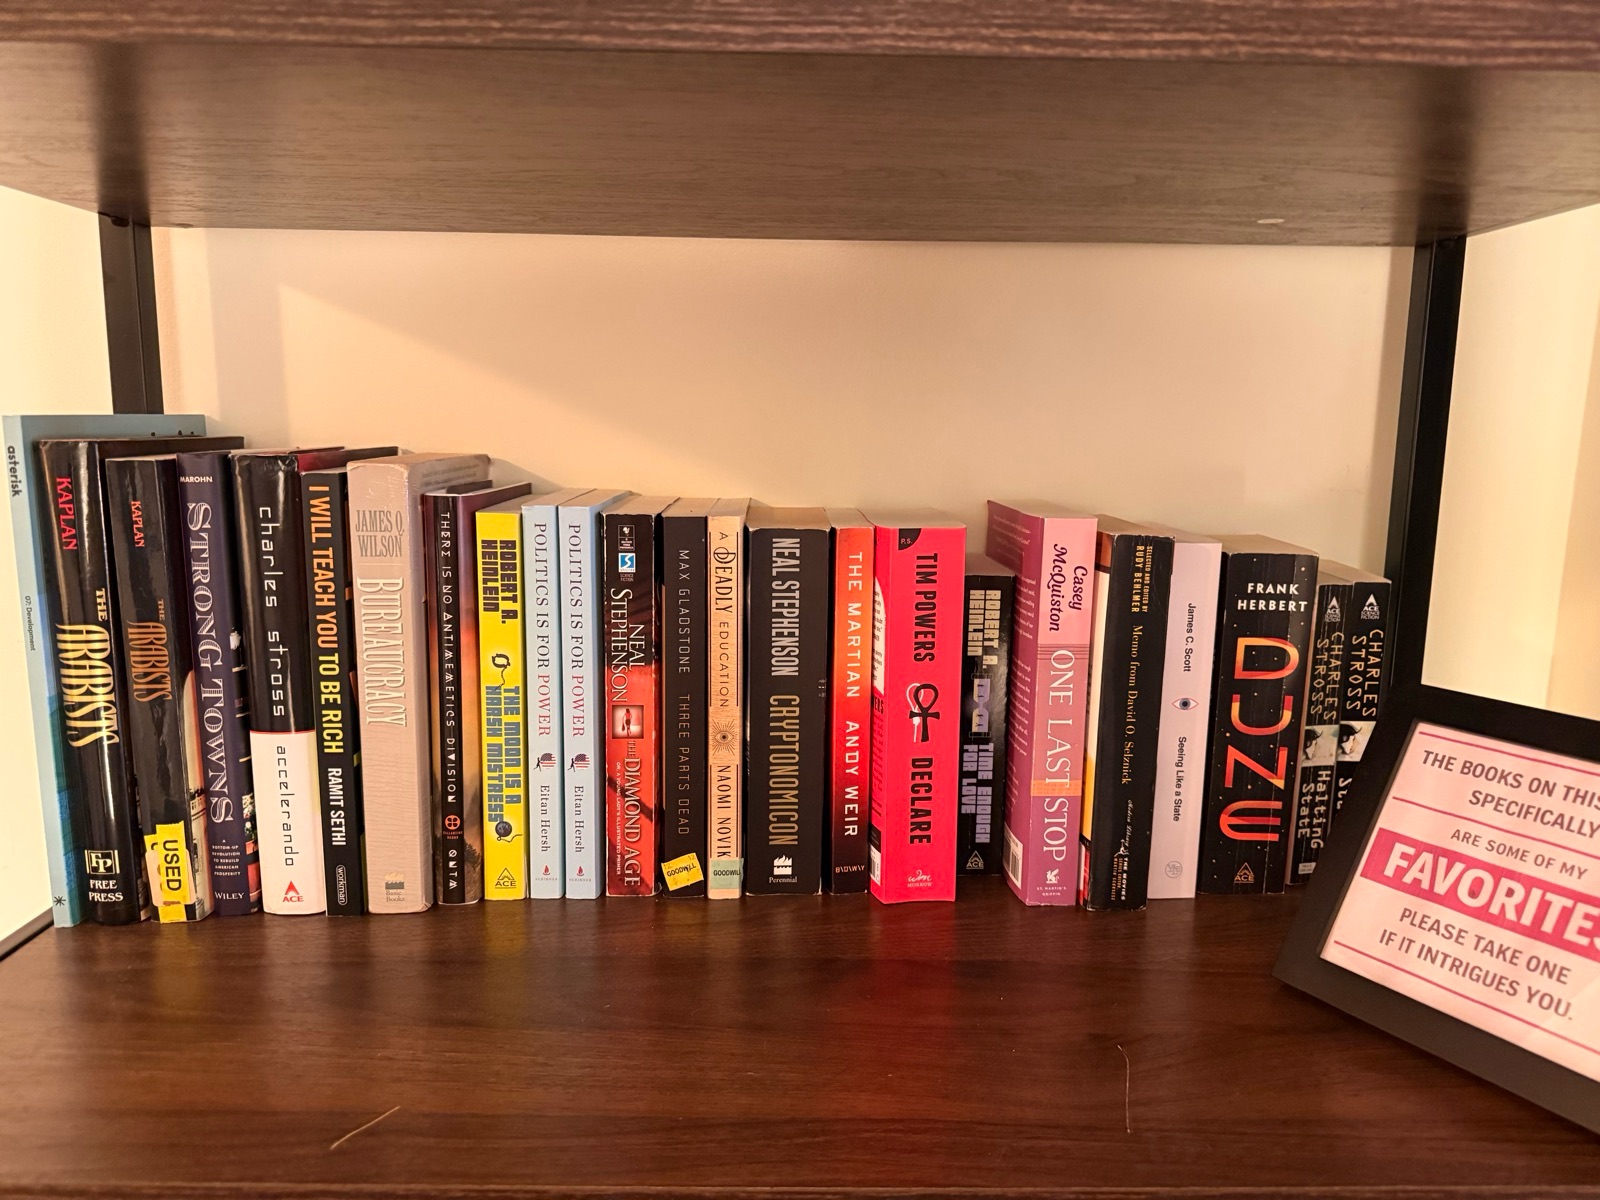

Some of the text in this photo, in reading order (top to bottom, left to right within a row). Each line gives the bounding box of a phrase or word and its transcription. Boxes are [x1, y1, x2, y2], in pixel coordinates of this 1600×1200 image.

[7, 445, 22, 497] asterisk
[179, 475, 213, 483] MAROHN
[56, 477, 77, 550] KAPLAN
[130, 500, 146, 548] KAPLAN
[309, 496, 332, 544] WILL
[355, 509, 392, 533] JAMES
[357, 535, 403, 558] WILSON
[96, 588, 108, 622] THE
[157, 598, 166, 621] THE
[259, 506, 289, 717] charles stross
[312, 547, 336, 607] TEACH
[481, 539, 500, 613] HEINLEIN
[499, 539, 519, 624] ROBERT A.
[770, 538, 800, 676] NEAL STEPHENSON
[913, 553, 938, 662] TIM POWERS
[1047, 543, 1068, 632] McQuiston
[1068, 565, 1088, 611] Casey
[1131, 546, 1145, 612] RUDY BEHLMER
[1237, 600, 1308, 612] HERBERT
[1247, 583, 1300, 595] FRANK
[26, 607, 36, 651] Development
[316, 611, 339, 649] YOU
[356, 576, 408, 727] BUREAUCRACY
[534, 523, 551, 737] POLITICS IS FOR POWER
[568, 523, 585, 737] POLITICS IS FOR POWER
[611, 588, 633, 702] STEPHENSON
[629, 624, 645, 671] NEAL
[713, 532, 736, 707] A DEADLY EDUCATION
[846, 552, 862, 697] THE MARTIAN
[967, 590, 985, 656] HEINLEIN
[983, 590, 1001, 648] ROBERT
[1183, 603, 1196, 672] James C. Scott
[55, 622, 120, 748] ARABISTS
[126, 619, 173, 703] ARABISTS
[187, 502, 234, 824] STRONG TOWNS
[318, 653, 340, 676] TO
[320, 681, 341, 705] BE
[440, 512, 456, 803] THERE IS NO ANTIMEMETICS DIVISION
[678, 550, 690, 834] MAX GLADSTONE THREE PARTS DEAD
[1311, 639, 1329, 714] STROSS
[1323, 632, 1344, 720] CHARLES
[1346, 635, 1367, 710] STROSS
[1362, 629, 1384, 717] CHARLES
[321, 709, 344, 754] RICH
[1121, 625, 1143, 784] Memo from David O. Selznick
[1219, 636, 1300, 841] DUNE
[485, 685, 504, 823] HARSH MISTRESS
[503, 686, 522, 805] THE MOON IS A
[768, 694, 800, 846] CRYPTONOMICON
[844, 720, 860, 837] ANDY WEIR
[961, 745, 978, 814] FOR LOVE
[1043, 649, 1075, 861] ONE LAST STOP
[1175, 737, 1187, 768] Seeing
[1175, 770, 1184, 789] Like
[1421, 750, 1457, 772] THE
[1459, 760, 1524, 789] BOOKS
[1528, 778, 1557, 798] ON
[276, 745, 300, 866] accelerando
[327, 767, 347, 846] RAMIT SETHI
[540, 785, 551, 852] Eitan Hersh
[574, 785, 585, 853] Eitan Hersh
[624, 741, 641, 886] THE DIAMOND AGE
[717, 765, 731, 858] NAOMI NOVIK
[910, 757, 933, 845] DECLARE
[975, 743, 994, 843] TIME ENOUGH
[1173, 798, 1182, 822] State
[1468, 790, 1600, 839] SPECIFICALLY
[90, 879, 118, 889] FREE
[162, 839, 182, 892] USED
[337, 867, 346, 905] workman
[666, 863, 696, 876] GOODWILL
[1450, 829, 1589, 880] ARE SOME OF MY
[88, 891, 124, 902] PRESS
[282, 895, 304, 903] ACE
[1378, 929, 1574, 1021] IF IT INTRIGUES YOU.
[1399, 907, 1571, 985] PLEASE TAKE ONE
